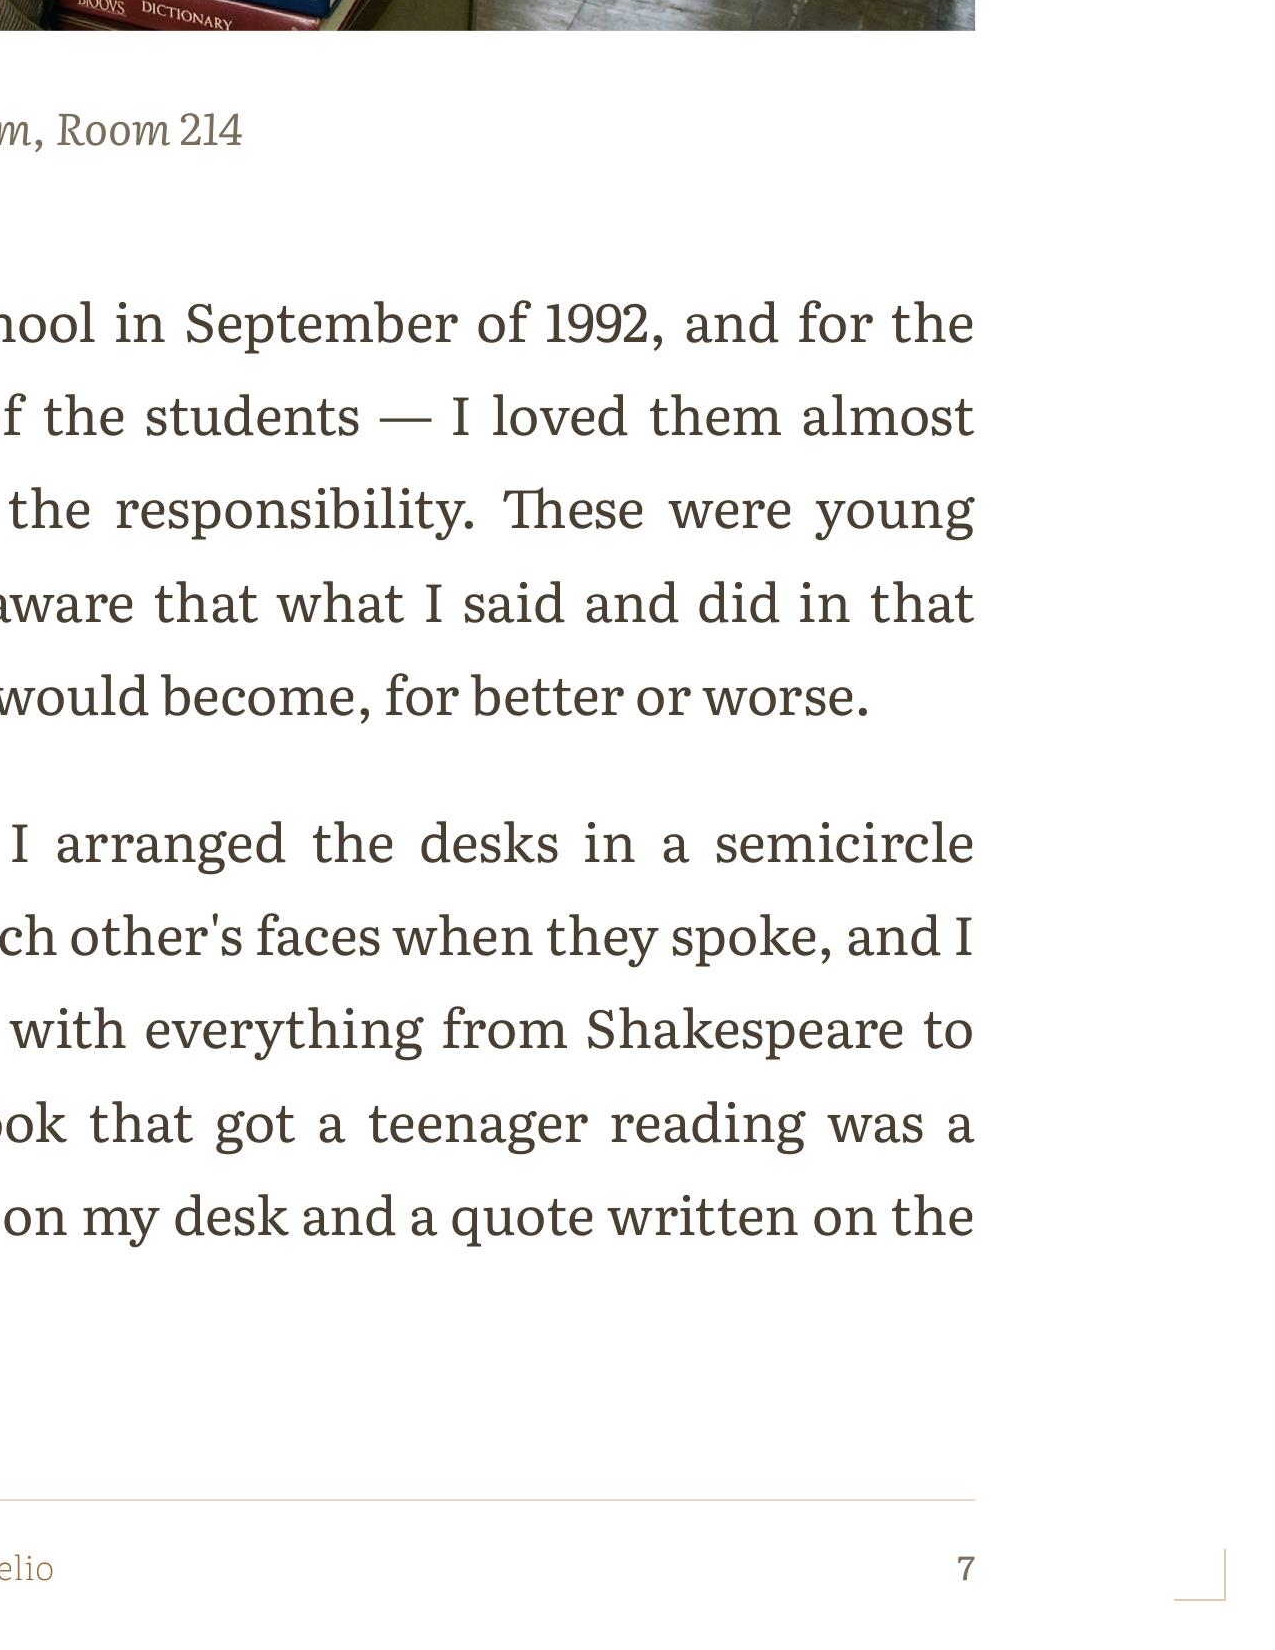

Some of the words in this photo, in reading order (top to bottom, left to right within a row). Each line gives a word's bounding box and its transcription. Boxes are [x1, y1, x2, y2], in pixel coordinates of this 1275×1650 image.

[141, 0, 233, 31] DICTIONARY
[56, 112, 171, 147] Room
[180, 112, 243, 146] 214
[115, 301, 166, 343] in
[186, 300, 459, 355] September
[477, 299, 532, 344] of
[546, 302, 663, 352] 1992,
[685, 300, 780, 344] and
[798, 299, 874, 344] for
[891, 300, 974, 344] the
[154, 580, 259, 624] that
[275, 580, 405, 624] what
[425, 583, 443, 623] I
[463, 580, 566, 624] said
[585, 580, 680, 624] and
[698, 580, 781, 624] did
[799, 581, 851, 623] in
[870, 580, 975, 624] that
[160, 673, 370, 725] become,
[385, 672, 460, 717] for
[470, 673, 625, 717] better
[636, 686, 692, 717] or
[701, 686, 868, 717] worse.
[11, 823, 29, 863] I
[56, 820, 287, 876] arranged
[312, 820, 394, 864] the
[420, 820, 559, 864] desks
[584, 821, 636, 863] in
[663, 833, 691, 864] a
[715, 820, 974, 864] semicircle
[70, 912, 243, 957] other's
[256, 912, 381, 957] faces
[391, 913, 534, 957] when
[546, 913, 660, 969] they
[671, 913, 831, 968] spoke,
[848, 913, 942, 957] and
[955, 916, 973, 956] I
[8, 1006, 127, 1050] with
[145, 1006, 425, 1062] everything
[442, 1005, 568, 1050] from
[587, 1006, 904, 1061] Shakespeare
[923, 1011, 973, 1050] to
[3, 1206, 68, 1237] on
[82, 1206, 161, 1248] my
[174, 1193, 290, 1237] desk
[302, 1193, 397, 1237] and
[410, 1206, 438, 1237] a
[451, 1198, 594, 1248] quote
[606, 1194, 799, 1237] written
[813, 1206, 878, 1237] on
[891, 1193, 974, 1237] the
[957, 1555, 976, 1582] 7
